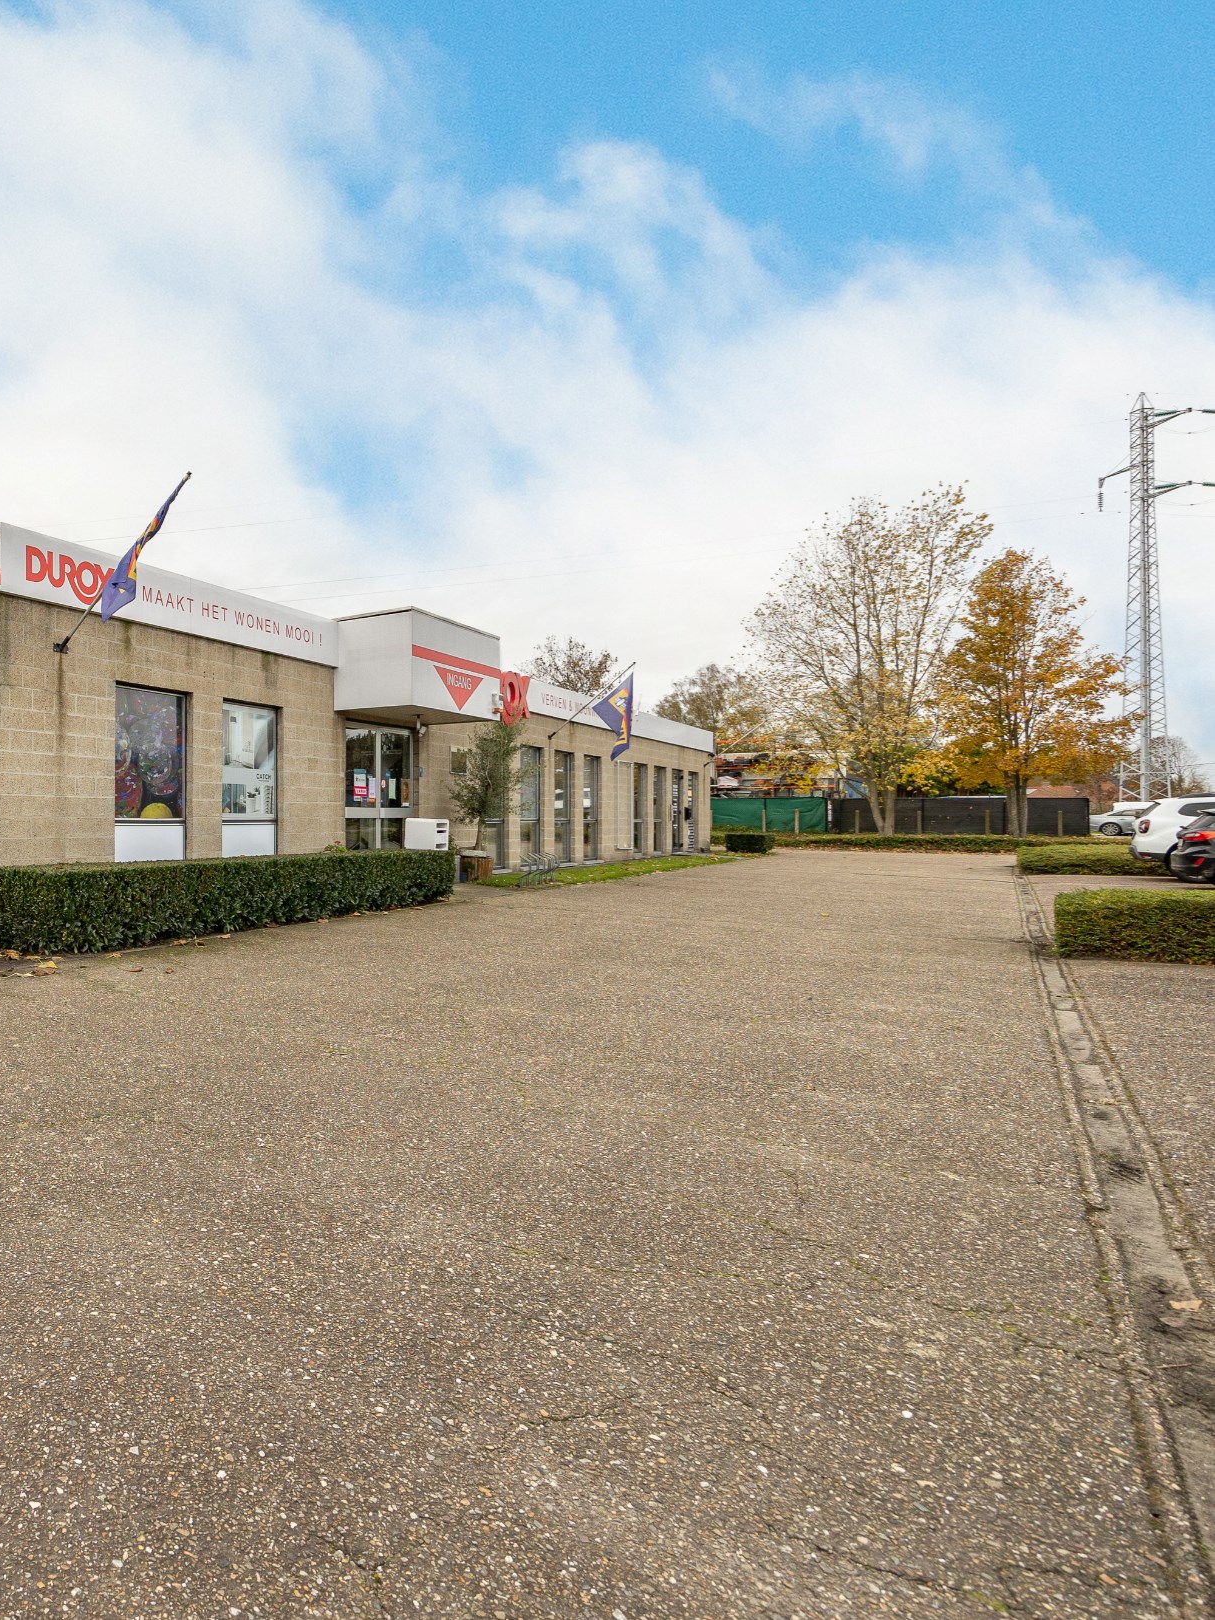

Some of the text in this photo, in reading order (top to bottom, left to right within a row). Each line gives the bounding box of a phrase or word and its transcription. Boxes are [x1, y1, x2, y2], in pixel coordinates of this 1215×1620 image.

[142, 585, 194, 613] MAAKT
[201, 601, 228, 622] HET
[234, 610, 280, 636] WONEN
[285, 624, 314, 644] MOOI
[446, 672, 472, 690] INGANG
[541, 692, 567, 711] VERVEN
